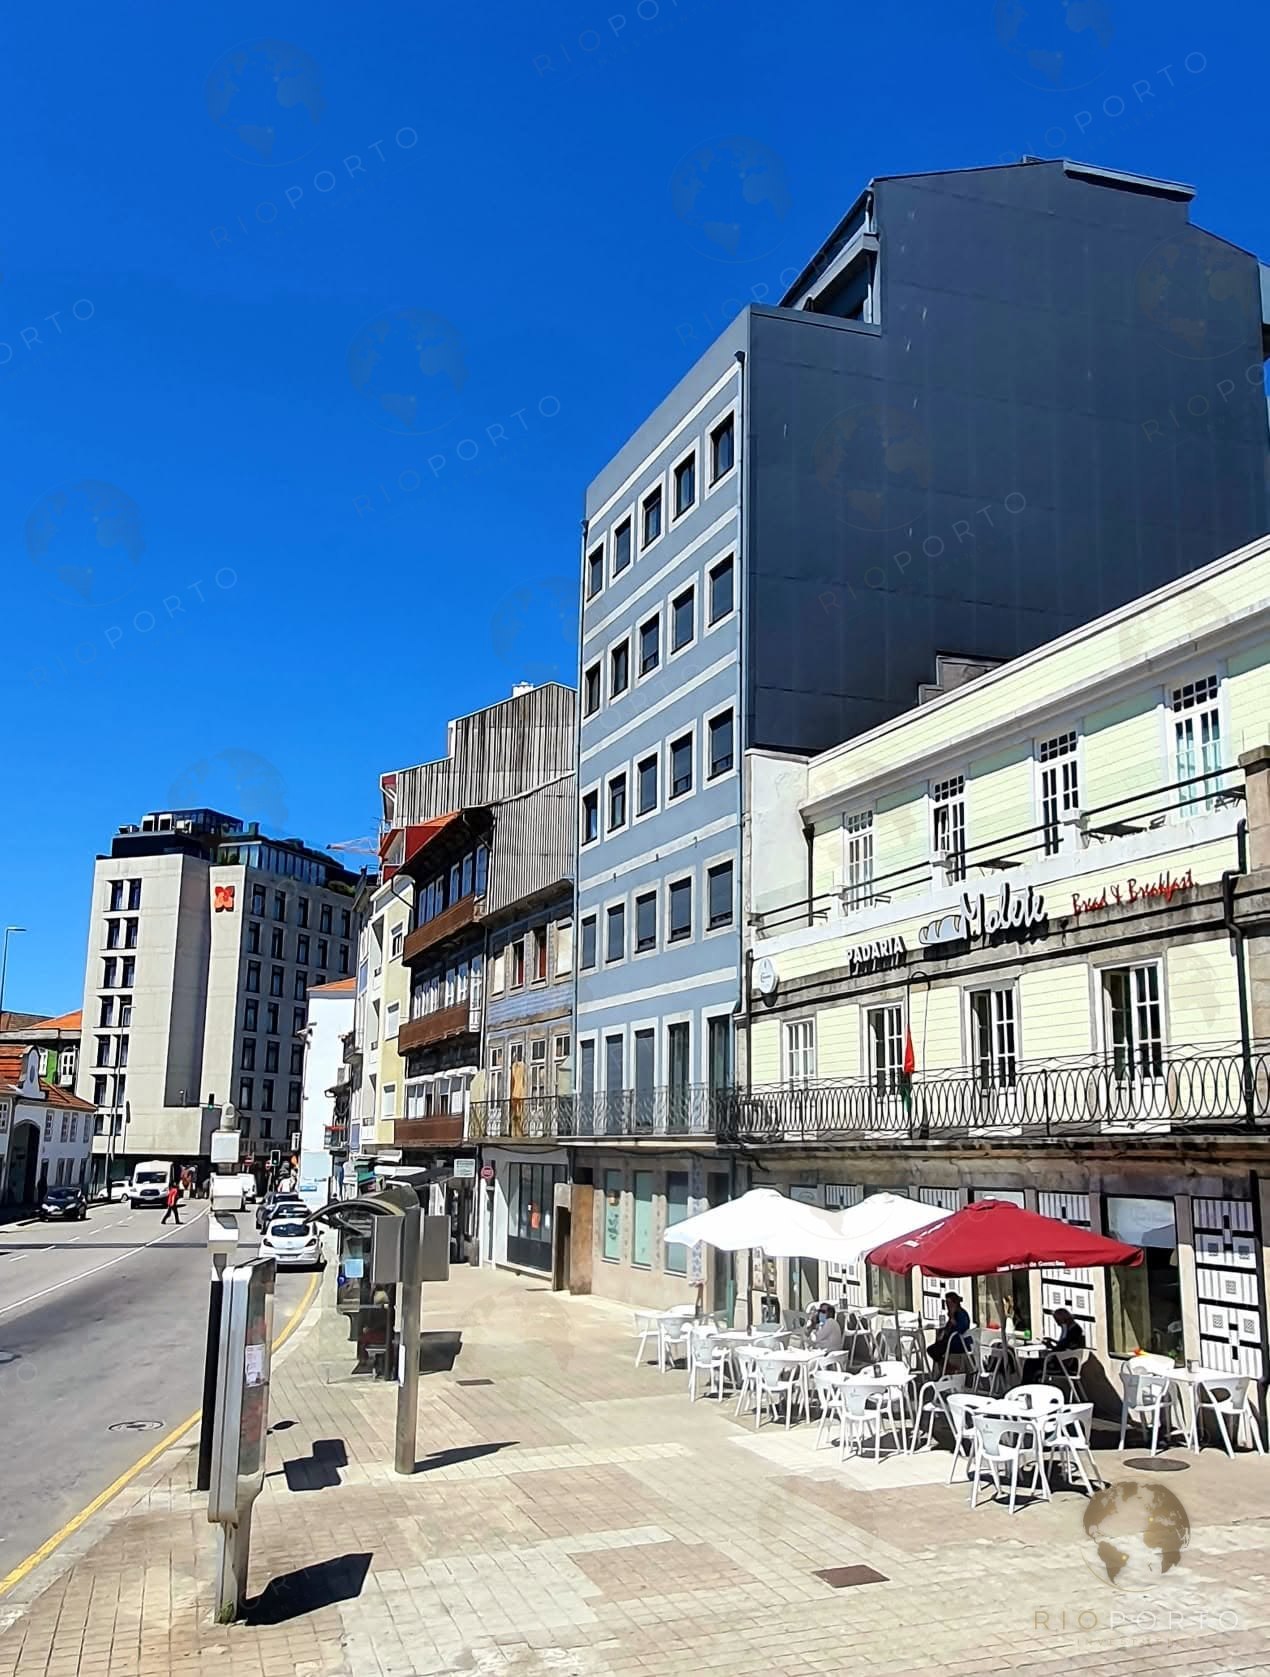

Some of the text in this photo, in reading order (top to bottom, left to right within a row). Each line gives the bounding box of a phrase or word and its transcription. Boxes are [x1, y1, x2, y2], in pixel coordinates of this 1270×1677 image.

[847, 867, 1194, 963] PADARIA Molete Bread & Breakfast
